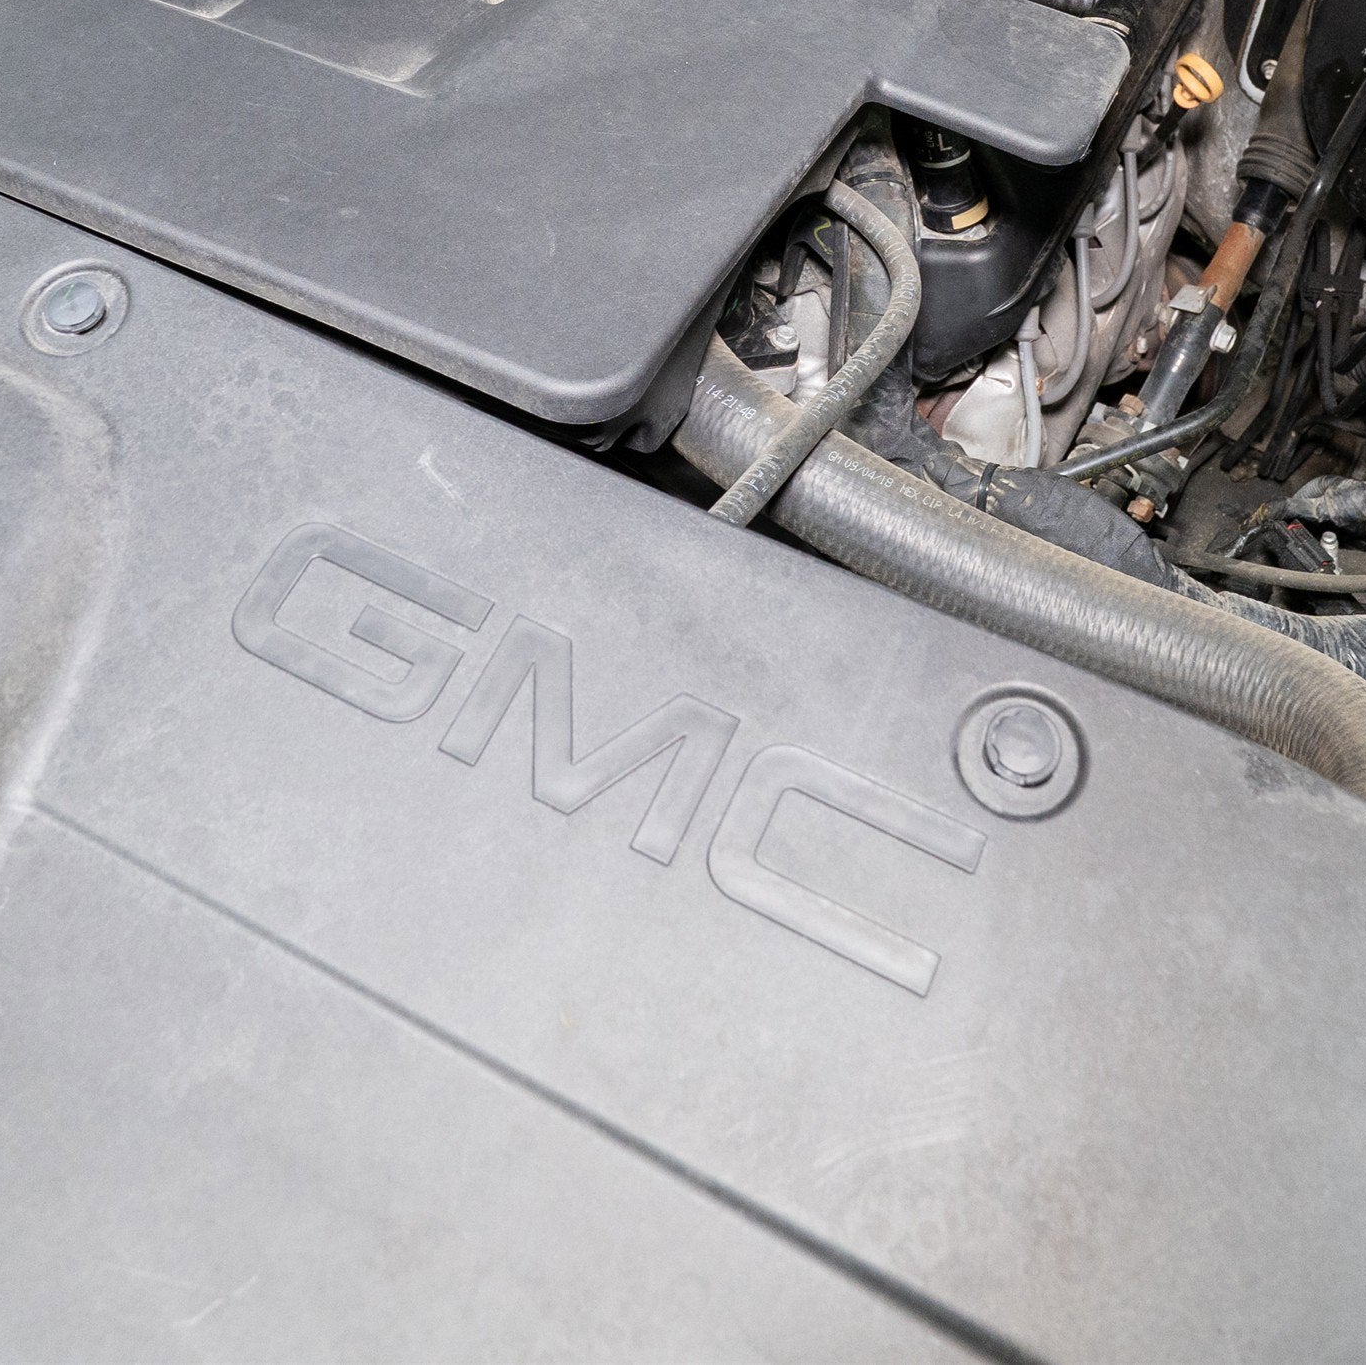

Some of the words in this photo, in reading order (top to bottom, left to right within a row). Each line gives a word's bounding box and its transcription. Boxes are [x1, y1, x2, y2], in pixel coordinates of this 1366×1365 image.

[706, 385, 757, 420] 14:21:48
[828, 451, 842, 464] GM
[232, 521, 988, 999] GMC
